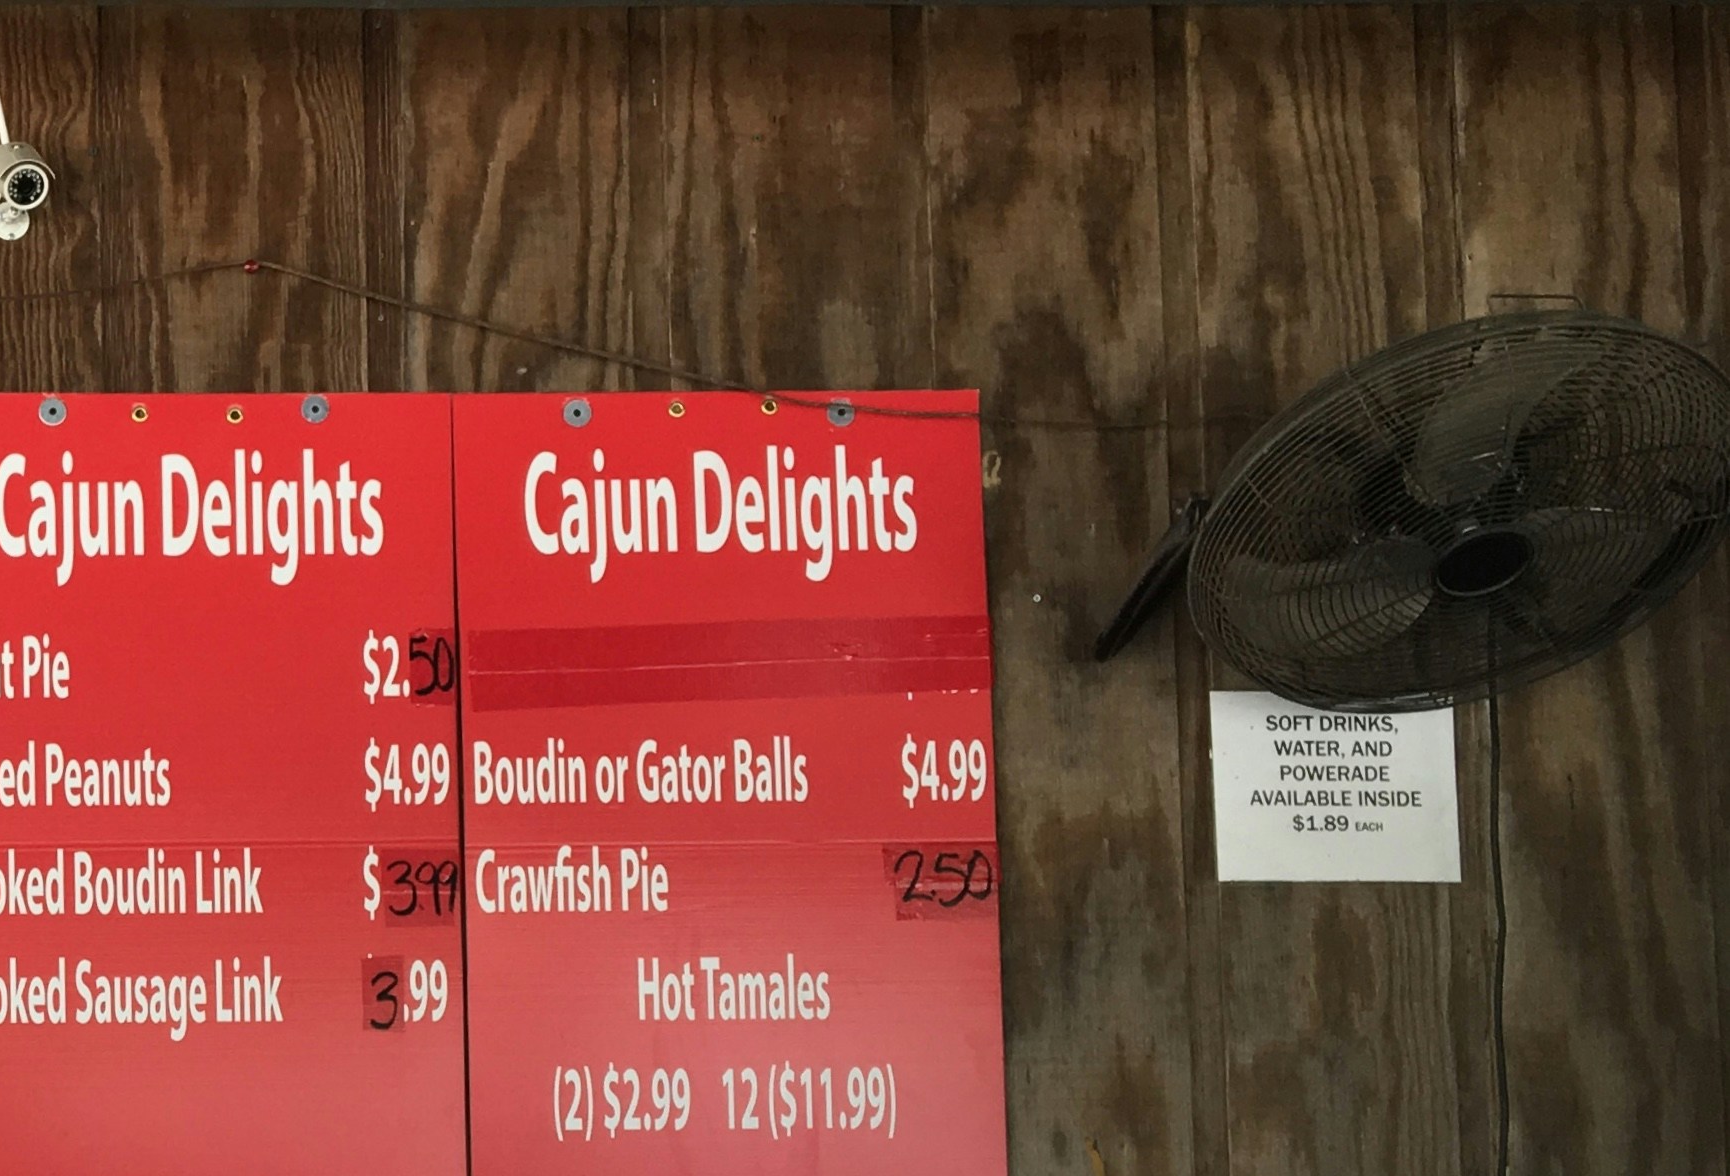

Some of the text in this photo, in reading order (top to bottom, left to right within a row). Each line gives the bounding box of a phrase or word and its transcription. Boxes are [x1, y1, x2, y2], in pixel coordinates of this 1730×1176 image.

[162, 449, 383, 585] Delights
[525, 445, 917, 583] Cajun Delights
[23, 634, 69, 698] Pie
[362, 628, 456, 706] $2.50
[1266, 714, 1399, 734] SOFT DRINKS,
[1274, 740, 1393, 759] WATER, AND
[46, 744, 170, 806] Peanuts
[365, 738, 449, 812] $4.99
[474, 734, 986, 808] Boudin or Gator Balls $4.99
[1250, 790, 1422, 808] AVAILABLE INSIDE
[1279, 765, 1390, 782] POWERADE
[1292, 814, 1384, 833] $1.89 EACH
[74, 848, 186, 914] Boudin
[196, 848, 263, 913] Link
[476, 845, 611, 913] Crawfish
[621, 847, 668, 911] Pie
[76, 960, 206, 1041] Sausage
[216, 956, 283, 1022] Link
[370, 959, 449, 1031] 3.99
[638, 954, 830, 1021] Hot Tamales
[554, 1061, 896, 1141] (2) $2.99 12 ($11.99)
